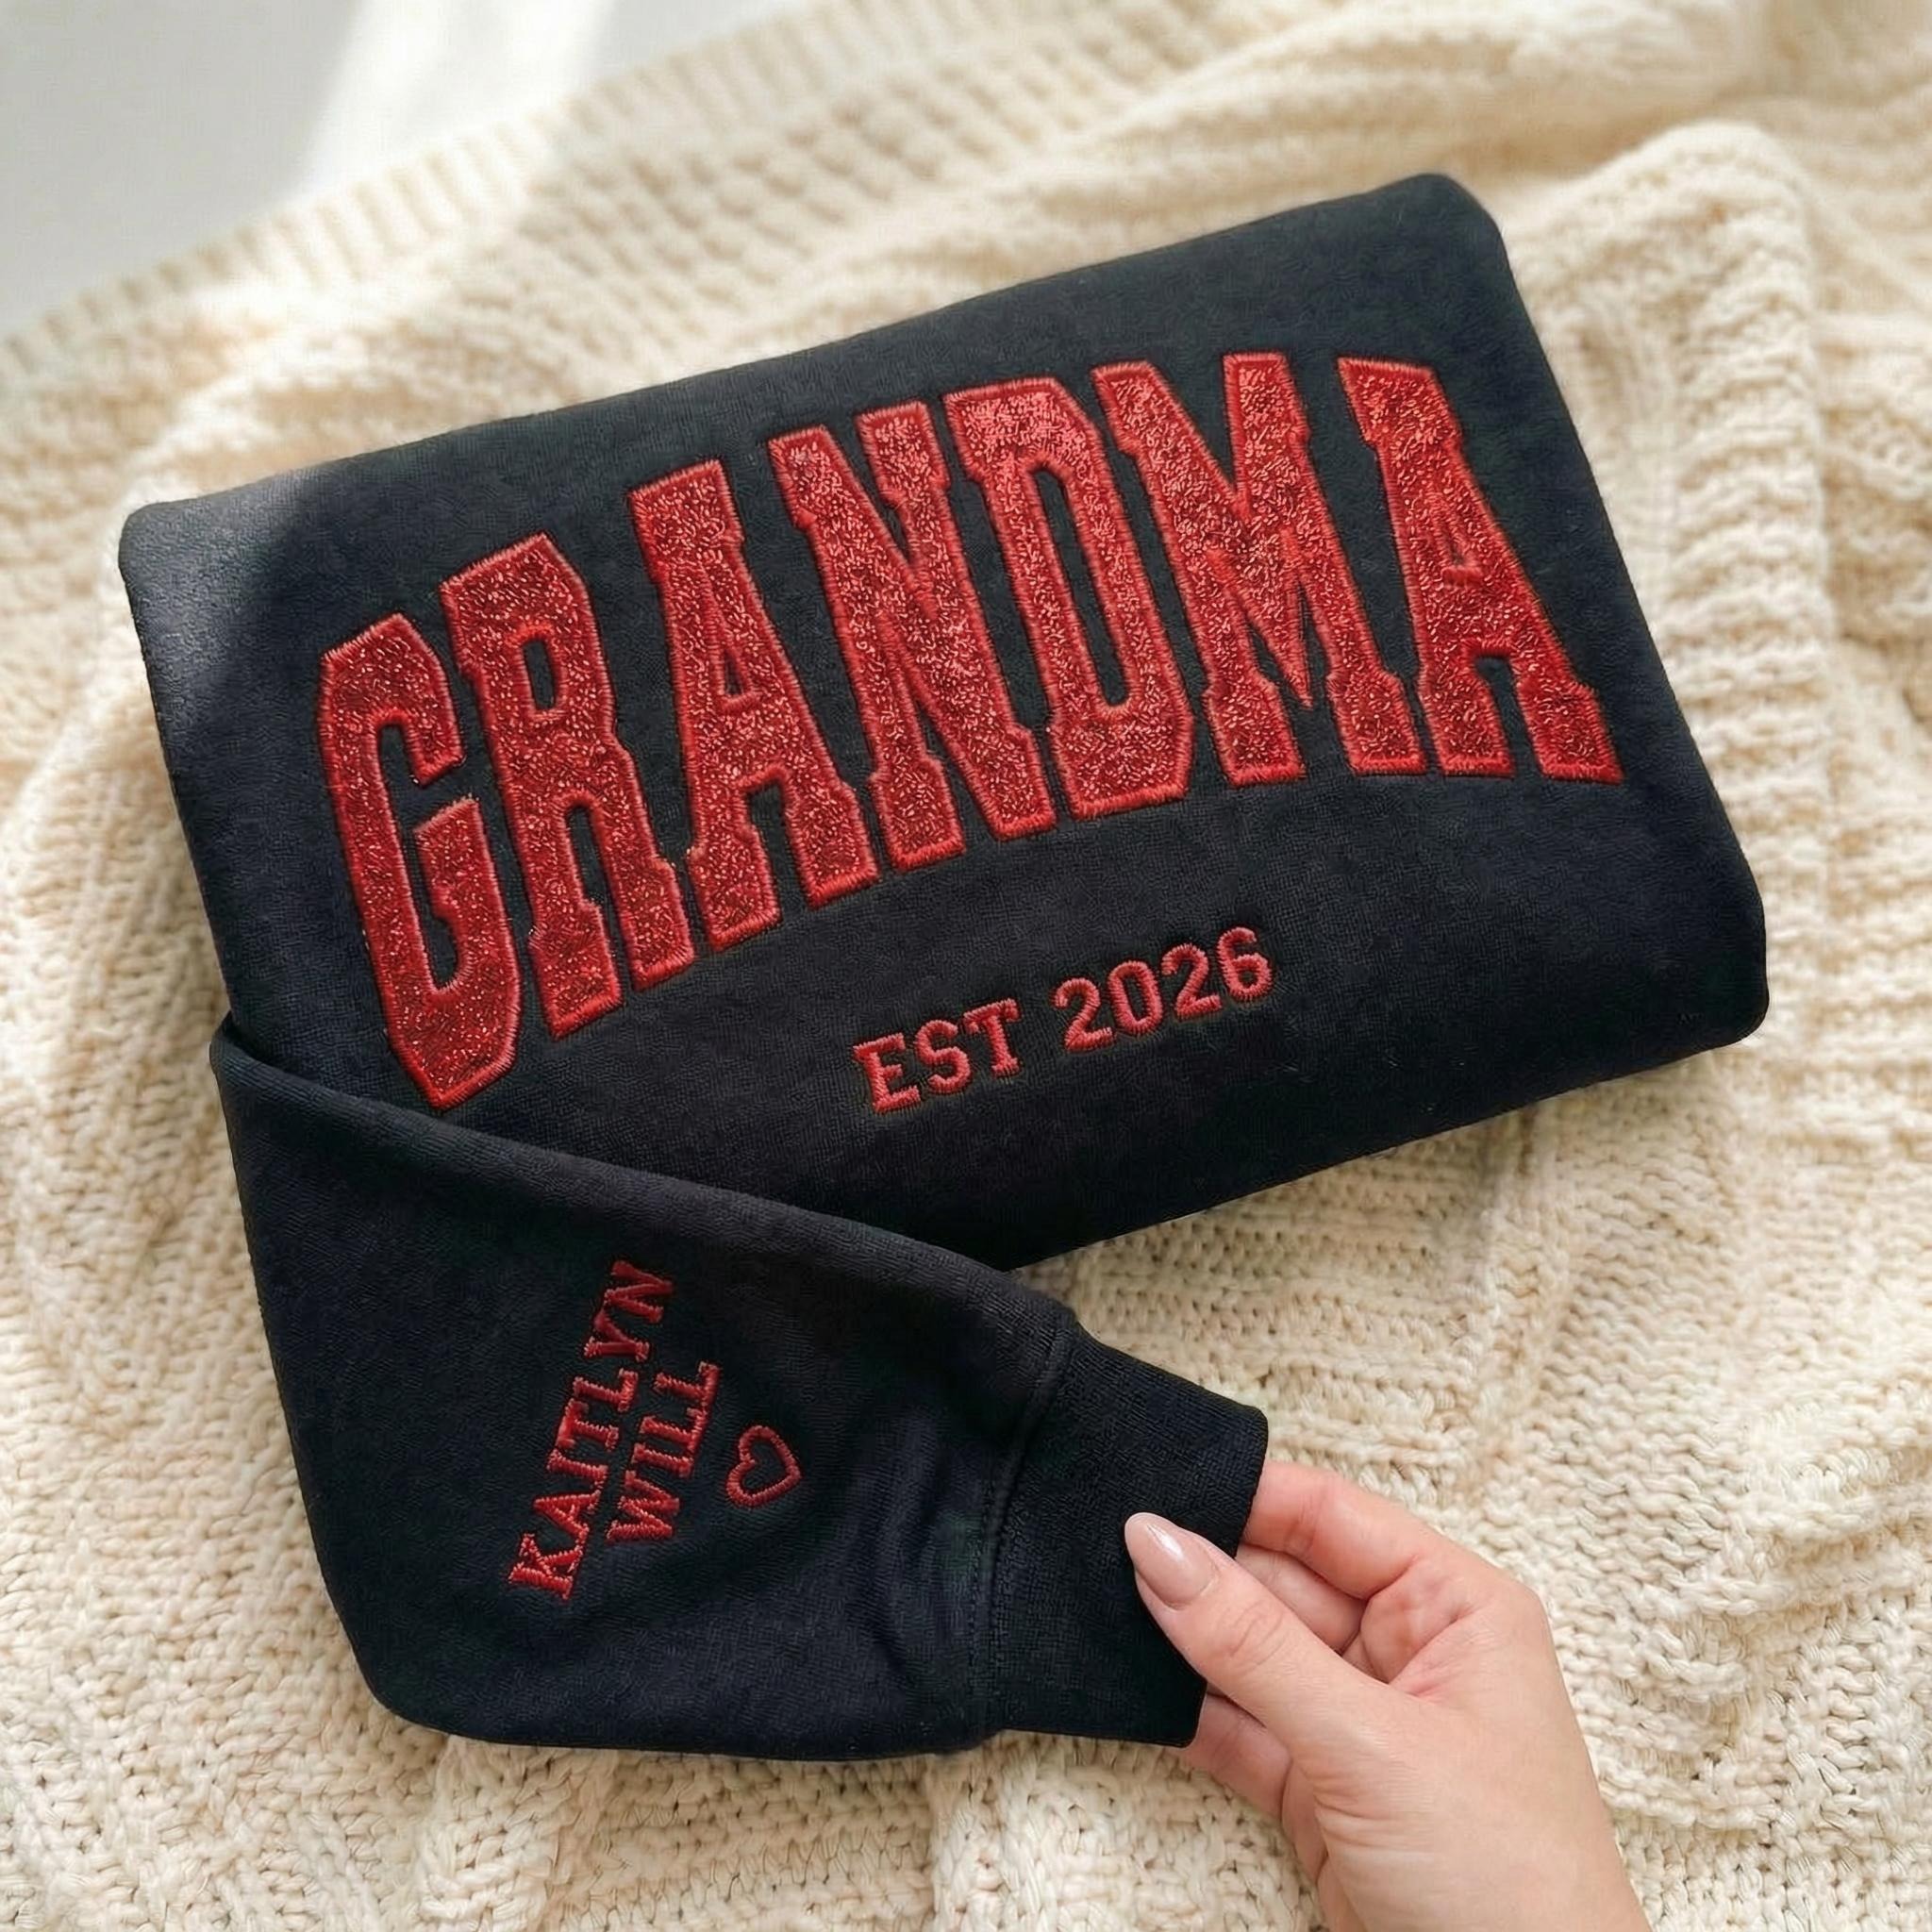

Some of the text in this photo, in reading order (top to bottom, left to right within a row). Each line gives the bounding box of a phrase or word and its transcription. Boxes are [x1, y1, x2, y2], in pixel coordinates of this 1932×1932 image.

[317, 351, 1623, 1108] GRANDMA
[852, 926, 1274, 1113] EST 2026
[510, 1260, 675, 1600] KAITLYN
[607, 1361, 720, 1543] WILL
